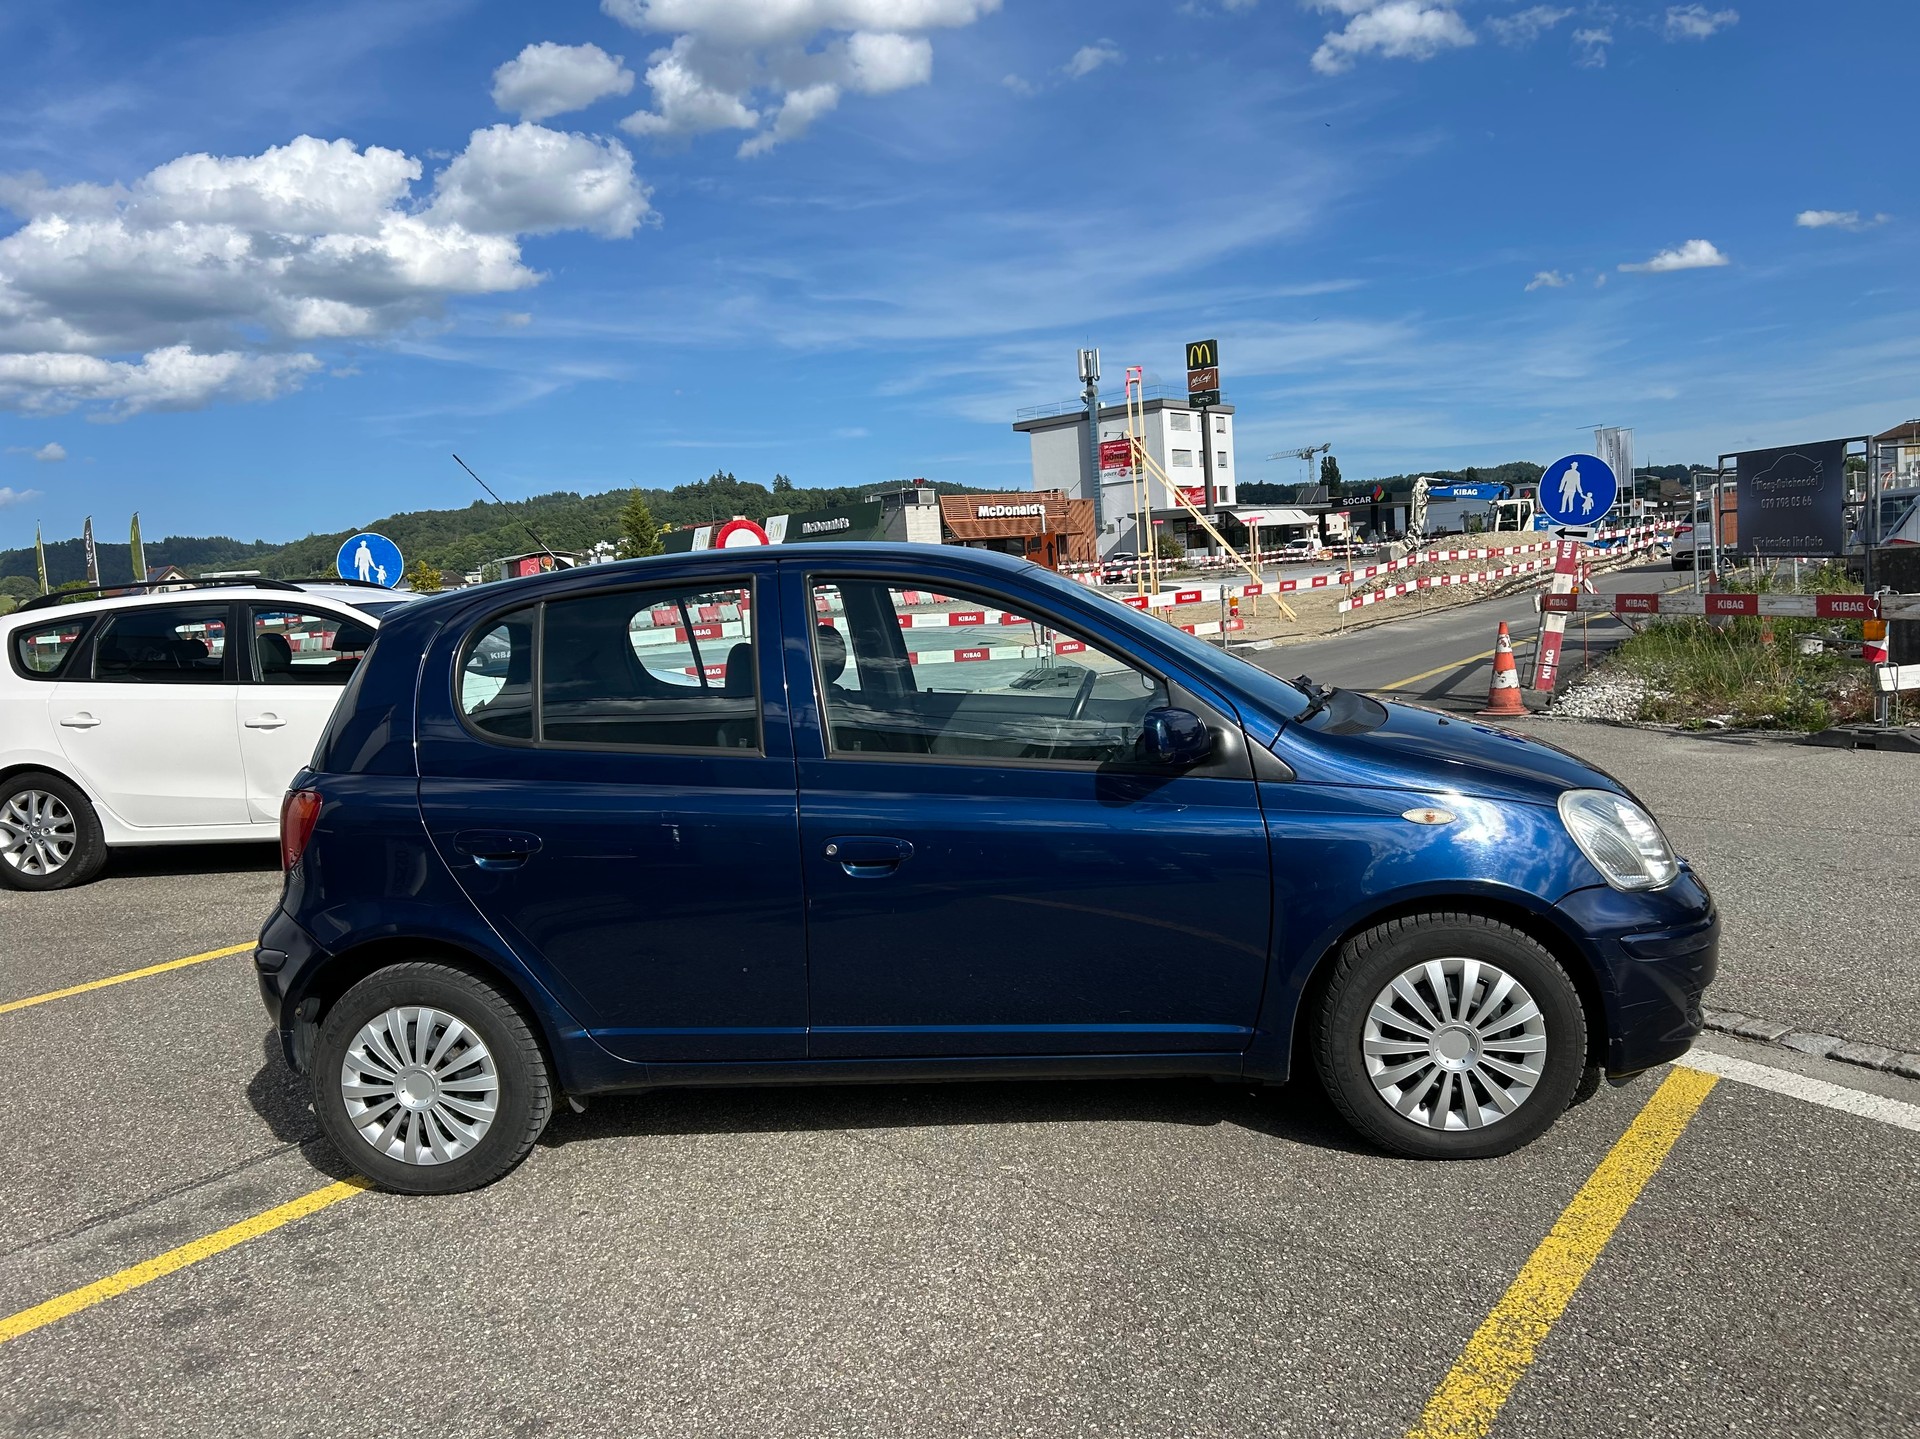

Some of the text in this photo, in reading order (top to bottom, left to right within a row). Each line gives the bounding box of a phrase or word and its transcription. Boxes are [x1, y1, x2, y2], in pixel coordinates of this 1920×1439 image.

[1453, 488, 1479, 496] KIBAG
[1342, 496, 1372, 506] SOCAR
[977, 503, 1046, 517] McDonald's
[1549, 598, 1568, 607] KIBAG
[1625, 598, 1649, 608] KIBAG
[1717, 600, 1745, 610] KIBAG
[1831, 601, 1865, 612] KIBAG
[1063, 643, 1079, 651] KIBAG
[490, 650, 511, 660] KIBA
[963, 651, 982, 659] KIBAG
